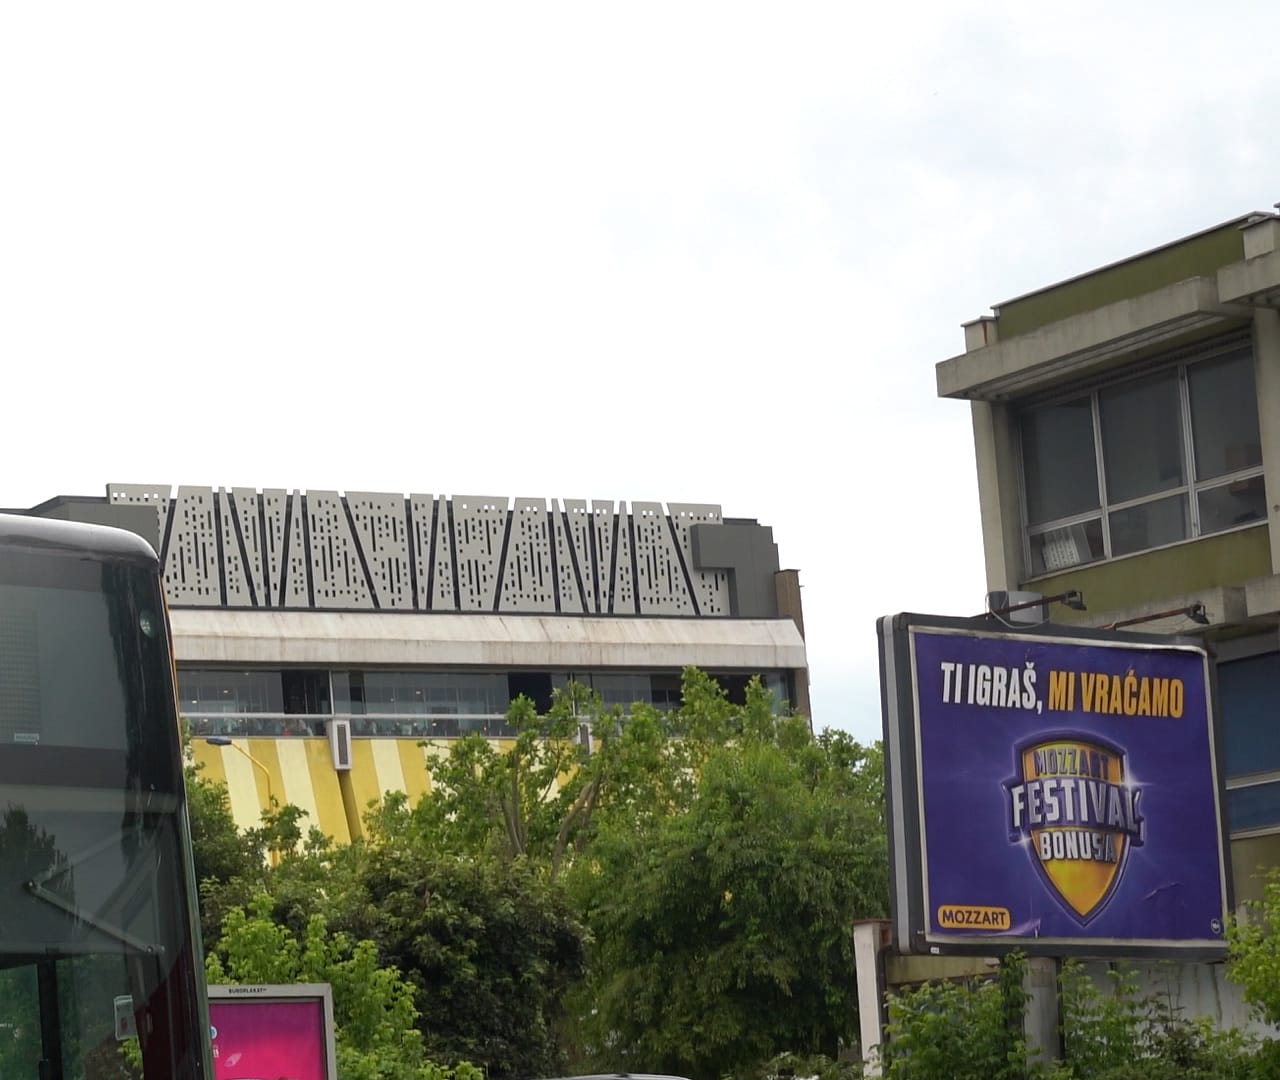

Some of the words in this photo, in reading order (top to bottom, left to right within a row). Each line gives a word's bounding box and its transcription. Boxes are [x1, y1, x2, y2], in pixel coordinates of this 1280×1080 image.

[941, 662, 963, 705] TI
[966, 661, 1043, 715] IGRAŠ,
[1048, 670, 1075, 712] MI
[1081, 668, 1185, 718] VRAĆAMO
[1033, 747, 1109, 781] MOZZART
[1011, 778, 1139, 833] FESTIVAL
[1040, 830, 1117, 863] BONUSA
[942, 910, 1006, 926] MOZZART
